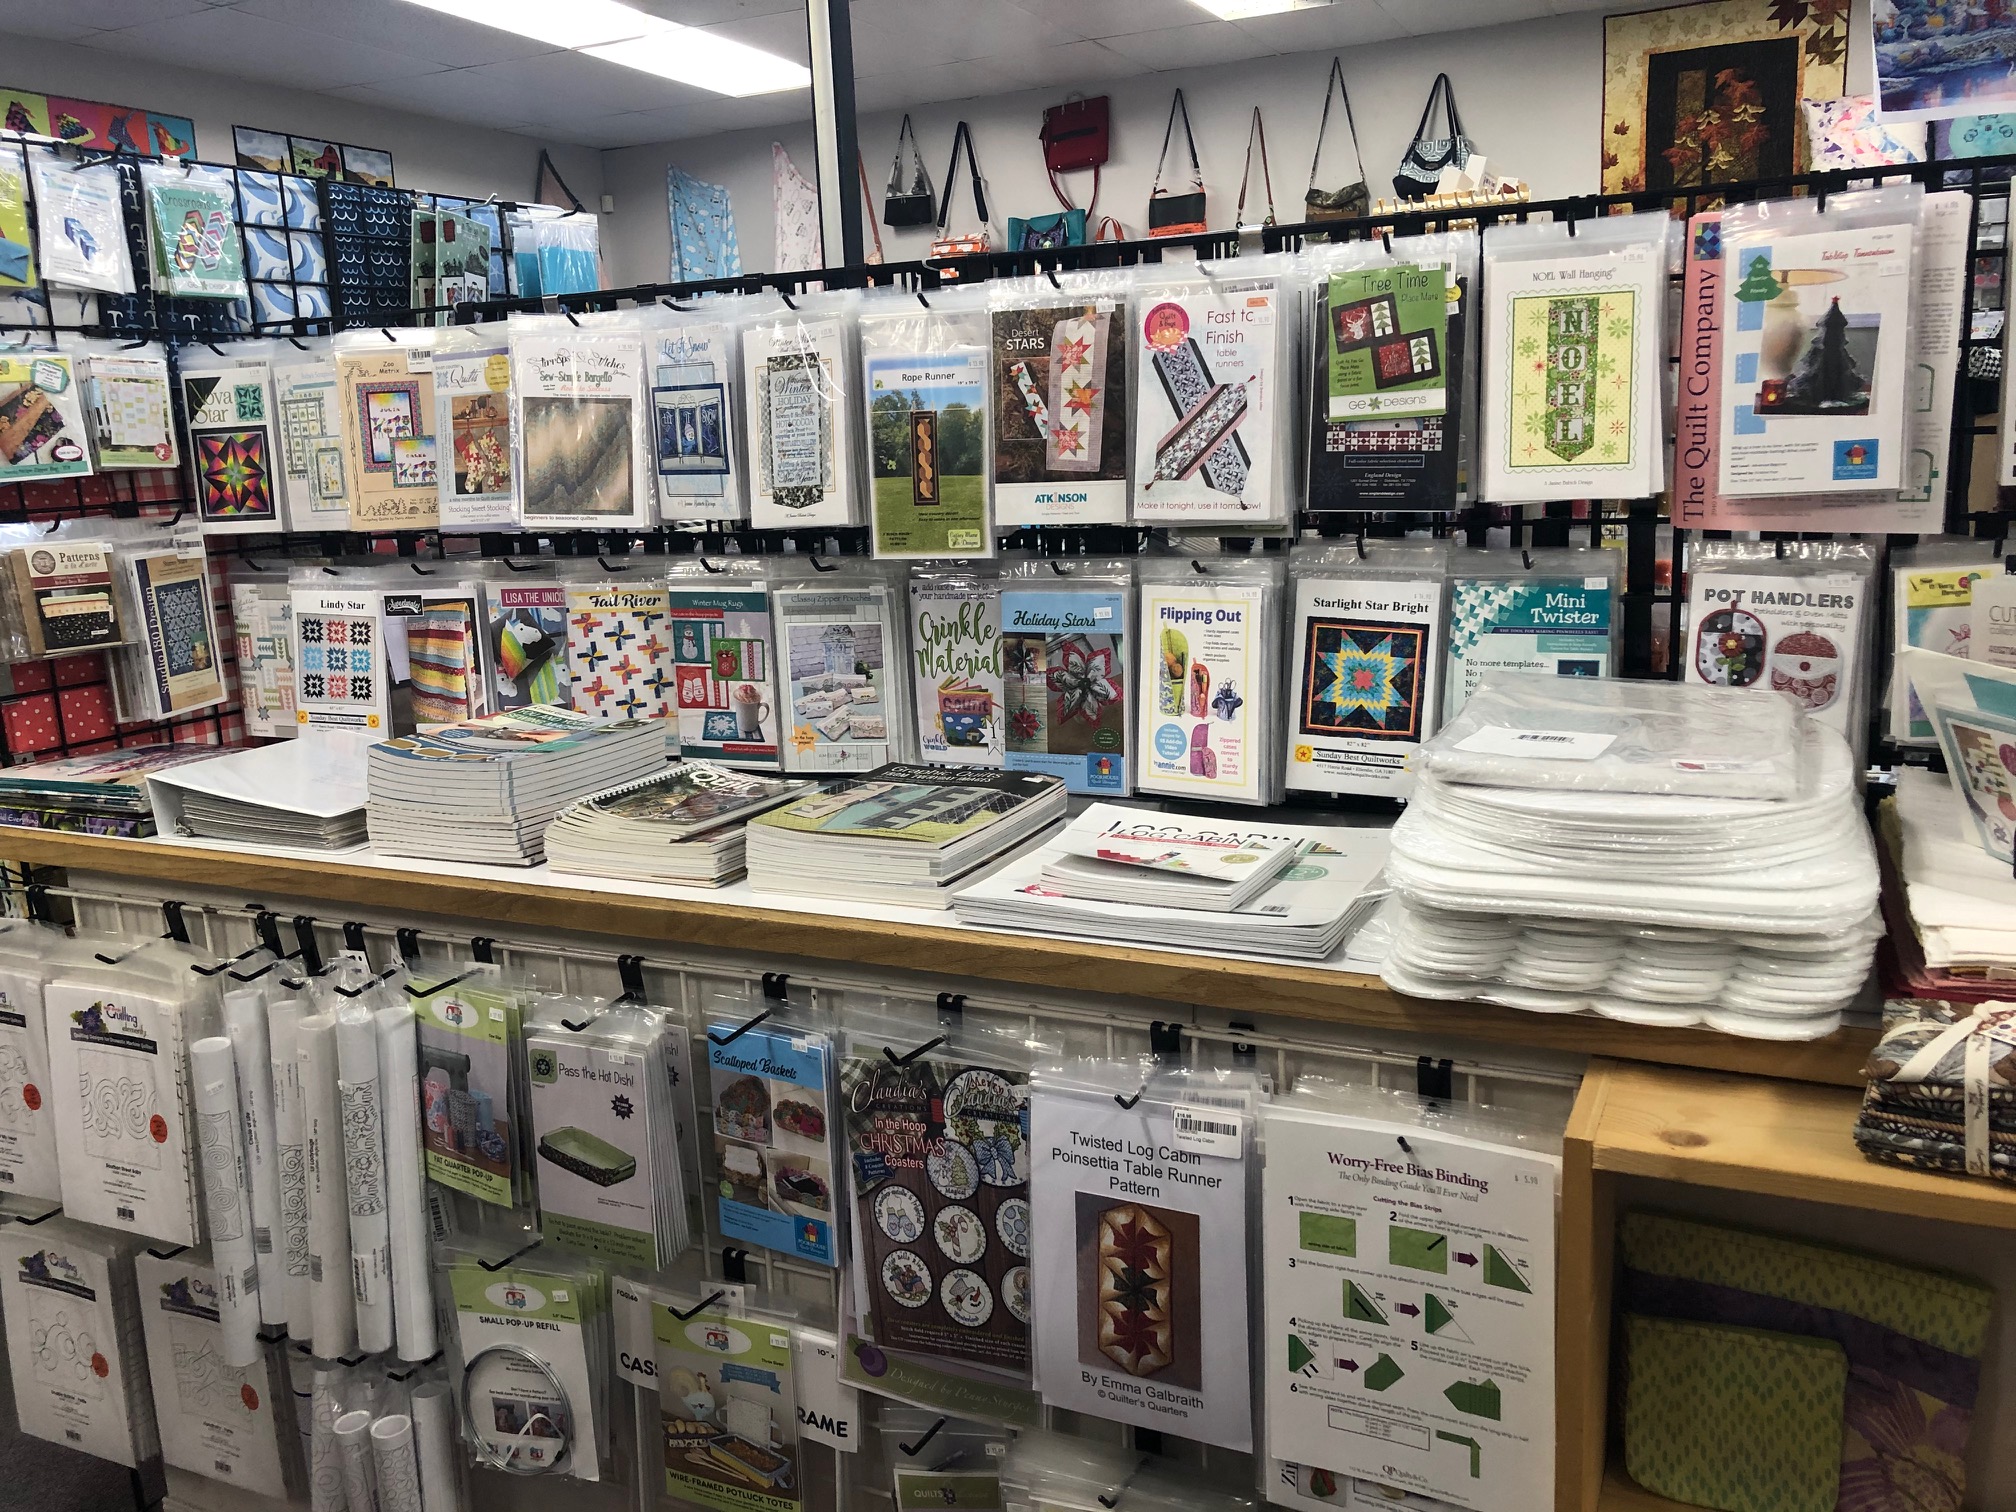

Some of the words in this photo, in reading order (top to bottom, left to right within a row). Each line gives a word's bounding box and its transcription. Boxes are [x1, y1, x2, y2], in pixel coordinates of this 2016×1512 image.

[1361, 276, 1392, 292] Tree
[1396, 272, 1429, 289] Time
[1533, 272, 1555, 282] NOEL
[1559, 270, 1576, 280] Wall
[1206, 310, 1235, 324] Fast
[1011, 328, 1039, 338] Desert
[1205, 331, 1244, 344] Finish
[1687, 268, 1720, 396] Company
[1006, 338, 1045, 350] STARS
[1216, 349, 1237, 358] table
[379, 367, 399, 375] Metrix
[1215, 359, 1244, 368] runners
[450, 366, 480, 389] Quilts
[584, 371, 613, 387] Bargello
[902, 374, 923, 384] Rope
[925, 372, 956, 382] Runner
[188, 380, 233, 408] Nova
[777, 395, 812, 405] HOLIDAY
[193, 401, 229, 425] Star
[1684, 403, 1711, 470] Quilt
[1137, 501, 1157, 510] Make
[1158, 501, 1165, 510] it
[1166, 501, 1196, 511] tonight,
[1212, 501, 1219, 510] it
[1682, 476, 1705, 522] The
[448, 506, 470, 514] Stocking
[59, 552, 100, 563] Patterns
[921, 583, 933, 591] add
[505, 592, 523, 604] LISA
[523, 592, 539, 603] THE
[589, 593, 619, 608] Fall
[622, 593, 661, 608] River
[713, 599, 727, 608] Mug
[728, 599, 744, 608] Rugs
[791, 595, 815, 603] Classy
[817, 595, 840, 604] Zipper
[918, 593, 933, 601] your
[934, 592, 966, 600] handmade
[1545, 593, 1586, 609] Mini
[1704, 588, 1746, 602] POT
[1751, 591, 1854, 609] HANDLERS
[145, 586, 158, 632] Design
[320, 600, 346, 610] Lindy
[347, 600, 366, 610] Star
[1313, 597, 1362, 612] Starlight
[1365, 600, 1389, 611] Star
[1392, 602, 1429, 615] Bright
[1753, 608, 1793, 617] Potholders
[919, 601, 997, 646] Crinkle
[1013, 610, 1061, 629] Holiday
[1062, 612, 1096, 628] Stars
[1160, 607, 1213, 624] Flipping
[1216, 609, 1242, 622] Out
[1531, 607, 1600, 625] Twister
[1799, 622, 1846, 632] personality
[151, 633, 161, 653] 180
[915, 634, 1003, 679] Material
[1466, 659, 1478, 667] No
[1503, 660, 1550, 669] templates...
[155, 654, 171, 694] Studio
[1465, 680, 1477, 688] No
[310, 714, 328, 722] Sunday
[1316, 751, 1341, 761] Sunday
[1344, 752, 1360, 761] Best
[1361, 755, 1401, 765] Quiltworks
[1116, 828, 1168, 839] LOG
[1173, 832, 1248, 845] CABIN
[713, 1049, 758, 1073] Scalloped
[759, 1058, 797, 1080] Baskets
[558, 1063, 578, 1078] Pass
[580, 1067, 596, 1080] the
[598, 1069, 612, 1083] Hot
[614, 1071, 634, 1087] Dish!
[851, 1066, 928, 1113] Claudia's
[875, 1103, 928, 1112] CREATIONS
[875, 1118, 884, 1128] In
[885, 1118, 901, 1130] the
[902, 1120, 927, 1135] Hoop
[860, 1133, 945, 1157] CHRISTMAS
[1070, 1131, 1123, 1153] Twisted
[1127, 1140, 1154, 1160] Log
[1159, 1146, 1201, 1166] Cabin
[433, 1156, 444, 1165] FAT
[444, 1158, 471, 1176] QUARTER
[471, 1168, 493, 1183] POP-UP
[884, 1154, 924, 1169] Coasters
[1052, 1148, 1119, 1172] Poinsettia
[1123, 1159, 1163, 1179] Table
[1168, 1167, 1222, 1189] Runner
[1327, 1151, 1404, 1174] Worry-Free
[1406, 1162, 1434, 1180] Bias
[1435, 1168, 1489, 1194] Binding
[1524, 1174, 1539, 1186] 5.98
[1109, 1176, 1160, 1198] Pattern
[1338, 1171, 1351, 1182] The
[1352, 1173, 1370, 1186] Only
[1371, 1175, 1399, 1190] Binding
[1400, 1180, 1421, 1192] Guide
[1422, 1183, 1442, 1197] You'll
[1443, 1187, 1458, 1199] Ever
[1460, 1190, 1479, 1202] Need
[1288, 1195, 1294, 1205] 1
[1373, 1195, 1396, 1205] Cutting
[1398, 1198, 1408, 1206] the
[1410, 1201, 1423, 1210] Bias
[1424, 1203, 1442, 1213] Strips
[1389, 1211, 1397, 1222] 2
[1288, 1257, 1296, 1268] 3
[479, 1316, 505, 1326] SMALL
[505, 1318, 534, 1328] POP-UP
[535, 1321, 561, 1332] REFILL
[1289, 1318, 1297, 1327] 4
[1410, 1340, 1418, 1351] 5
[890, 1367, 936, 1395] Designed
[1290, 1383, 1298, 1392] 6
[1082, 1370, 1098, 1387] By
[1101, 1376, 1142, 1395] Emma
[1145, 1386, 1204, 1410] Galbraith
[1108, 1391, 1146, 1408] Quilter's
[1148, 1402, 1189, 1419] Quarters
[669, 1471, 724, 1494] WIRE-FRAMED
[726, 1485, 764, 1503] POTLUCK
[766, 1495, 794, 1511] TOTES
[914, 1488, 943, 1498] QUILTS
